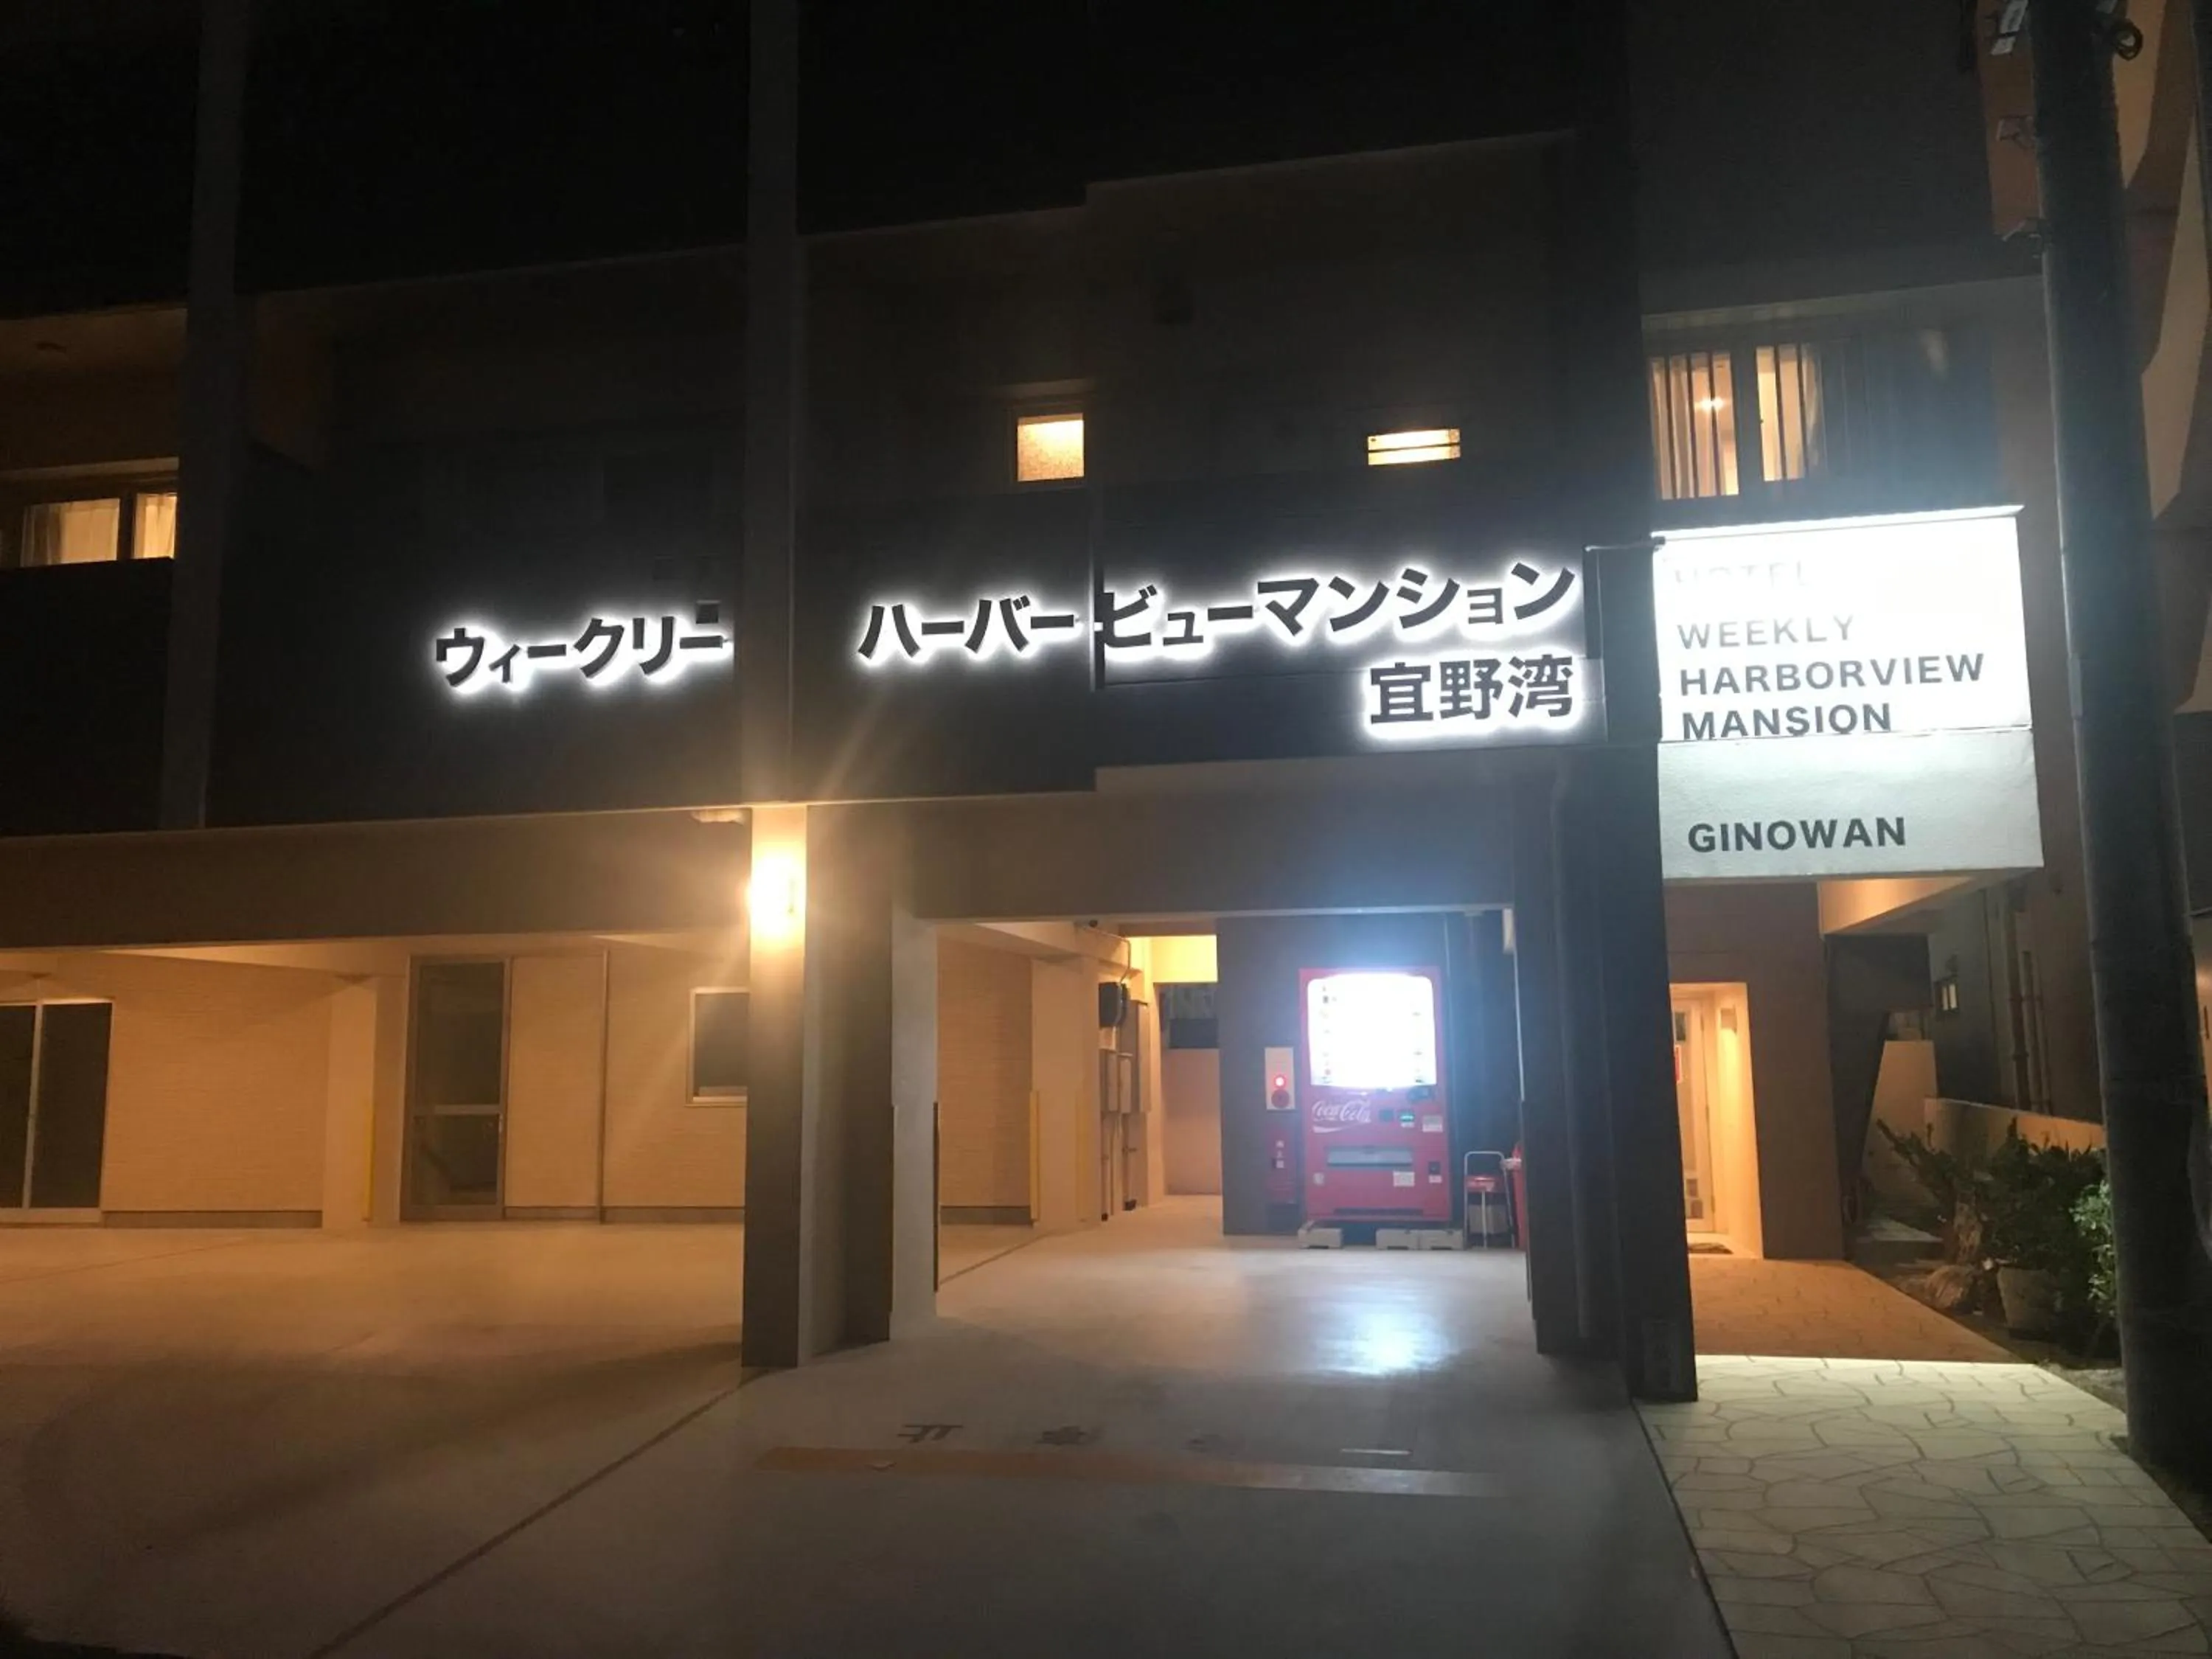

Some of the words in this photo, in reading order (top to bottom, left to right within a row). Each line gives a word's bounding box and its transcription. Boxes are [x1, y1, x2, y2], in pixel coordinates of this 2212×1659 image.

[436, 616, 723, 686] ウィークリー
[858, 561, 1576, 659] ハーバービューマンション
[1677, 615, 1854, 650] WEEKLY
[1369, 653, 1573, 725] 宜野湾
[1680, 653, 1984, 696] HARBORVIEW
[1682, 702, 1891, 740] MANSION
[1688, 816, 1906, 853] GINOWAN
